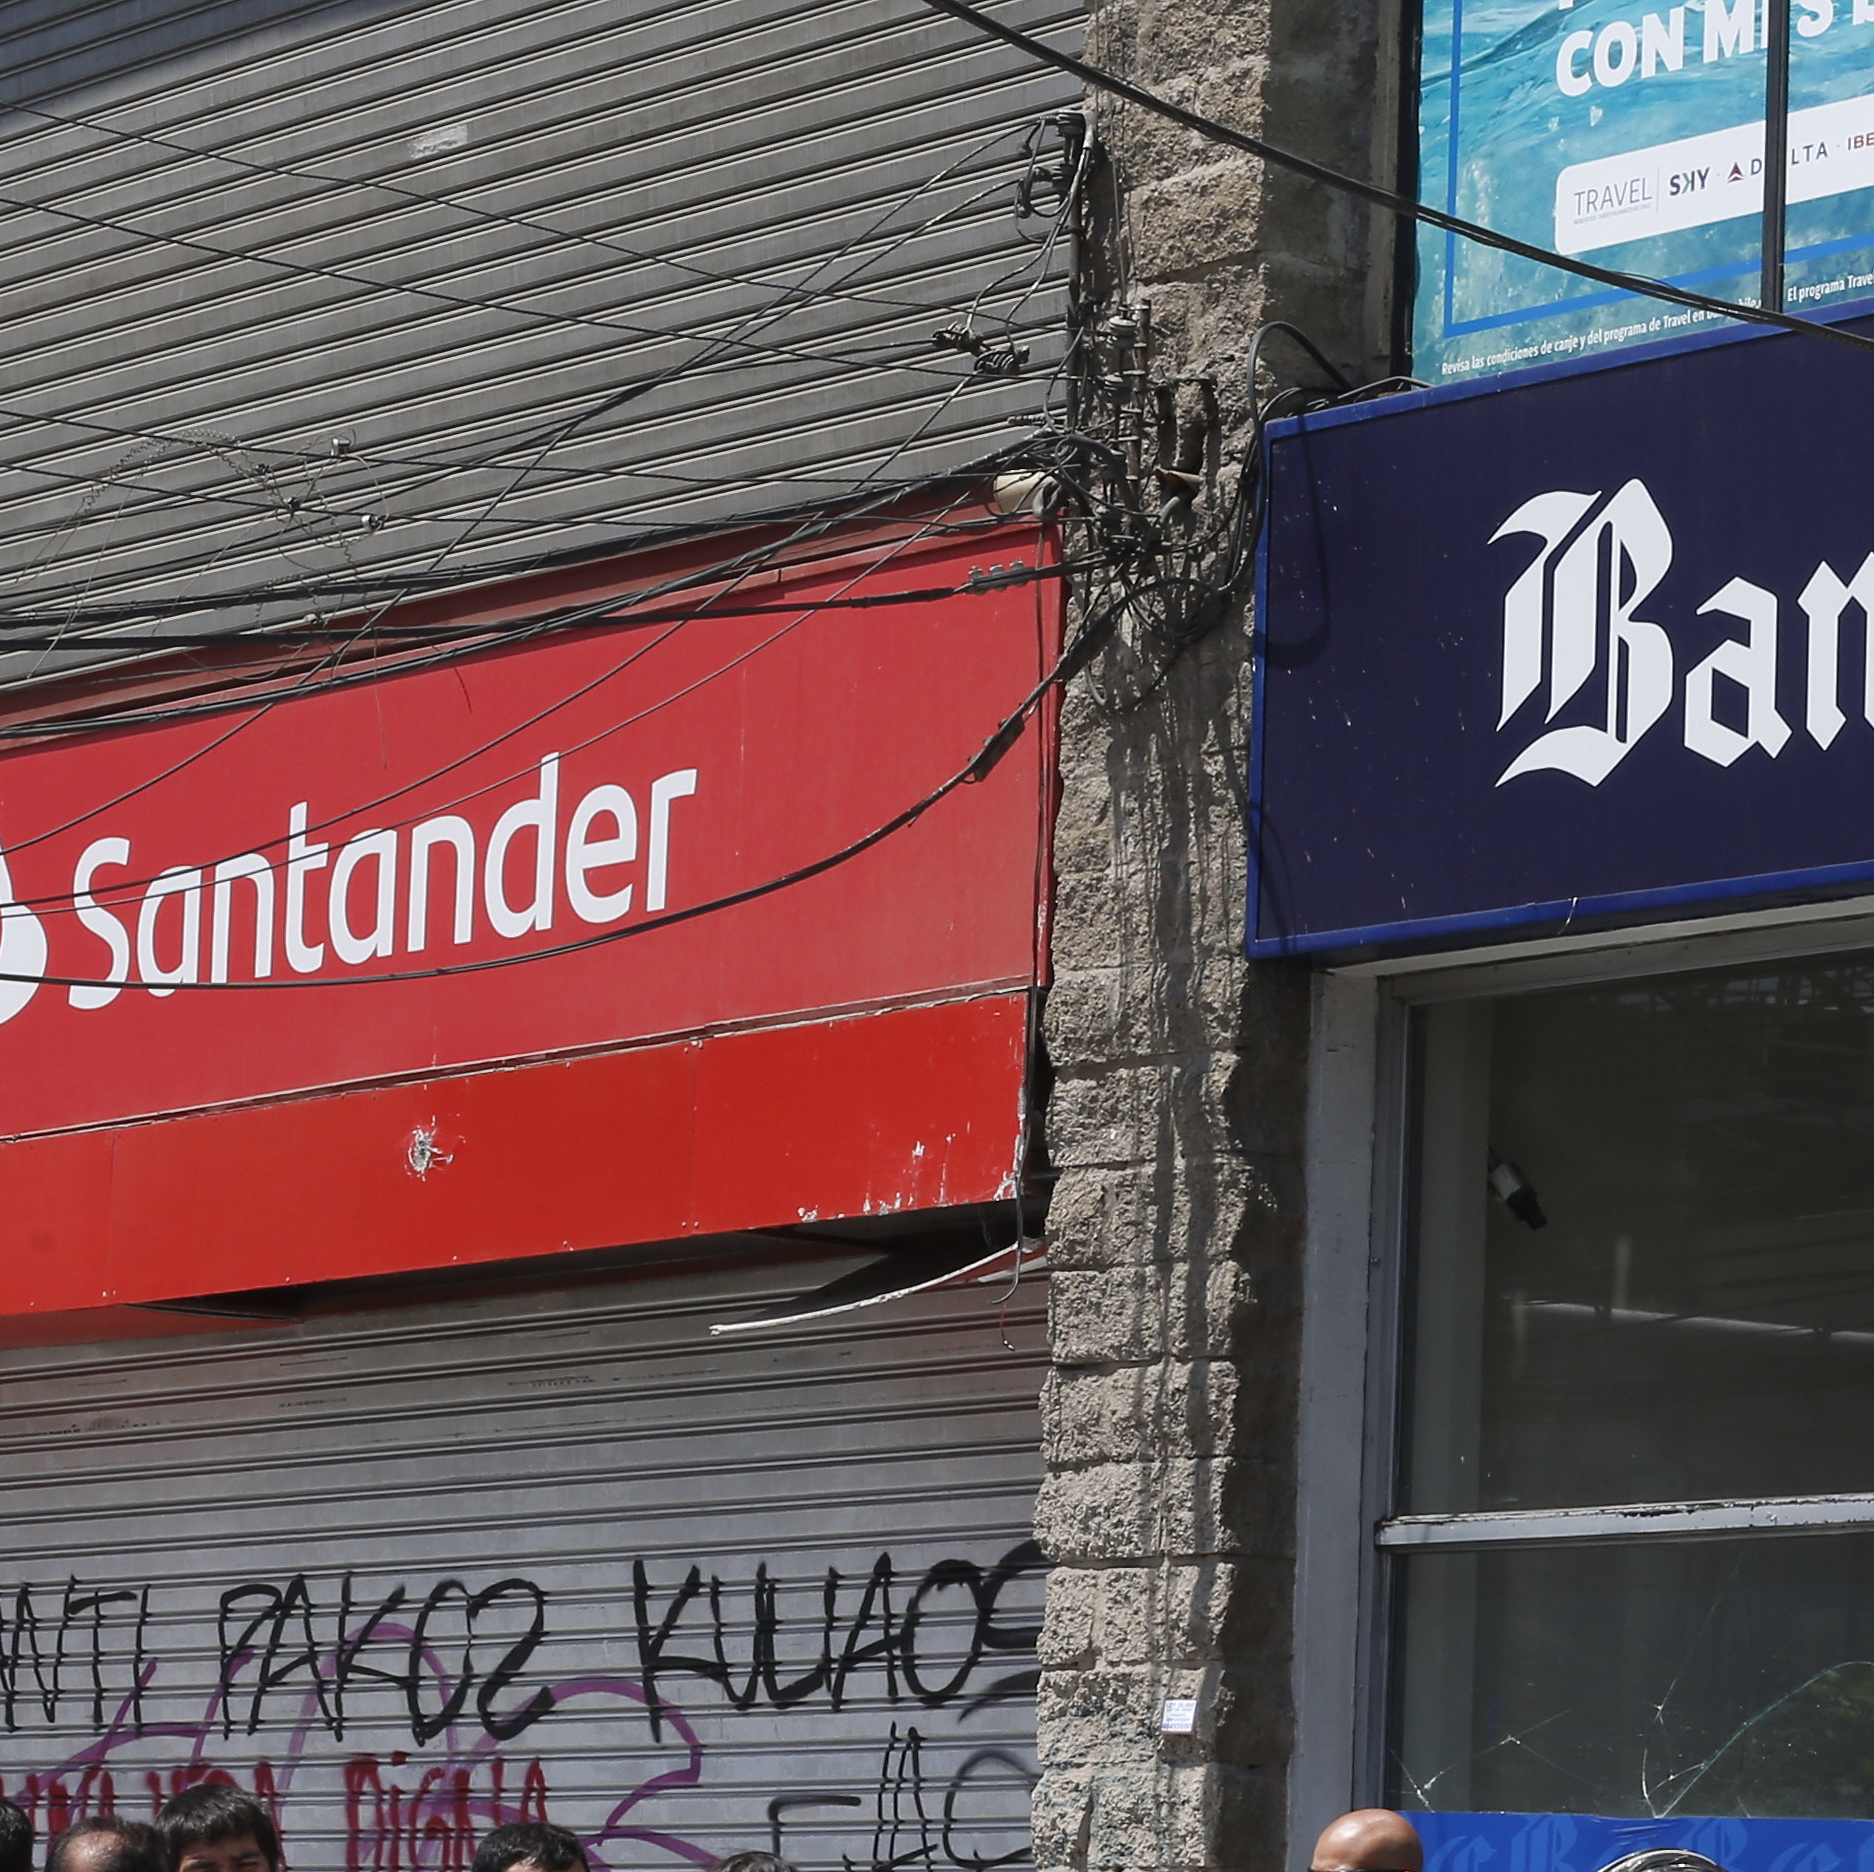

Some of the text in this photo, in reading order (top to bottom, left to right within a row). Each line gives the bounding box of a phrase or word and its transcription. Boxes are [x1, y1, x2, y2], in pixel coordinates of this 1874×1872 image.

[1555, 13, 1684, 98] CON
[1573, 177, 1652, 216] TRAVEL
[1669, 166, 1711, 197] SKY
[1750, 141, 1828, 176] DLTA
[1442, 360, 1470, 376] Revisa
[1472, 353, 1485, 369] las
[1487, 342, 1538, 366] condiciones
[1541, 338, 1552, 354] de
[1554, 337, 1578, 357] canje
[1578, 337, 1587, 351] y
[1588, 327, 1602, 345] del
[1603, 322, 1647, 348] programa
[1648, 316, 1661, 332] de
[1663, 307, 1692, 328] Travel
[1787, 285, 1797, 301] El
[1798, 278, 1845, 303] programa
[67, 752, 697, 1010] Santander
